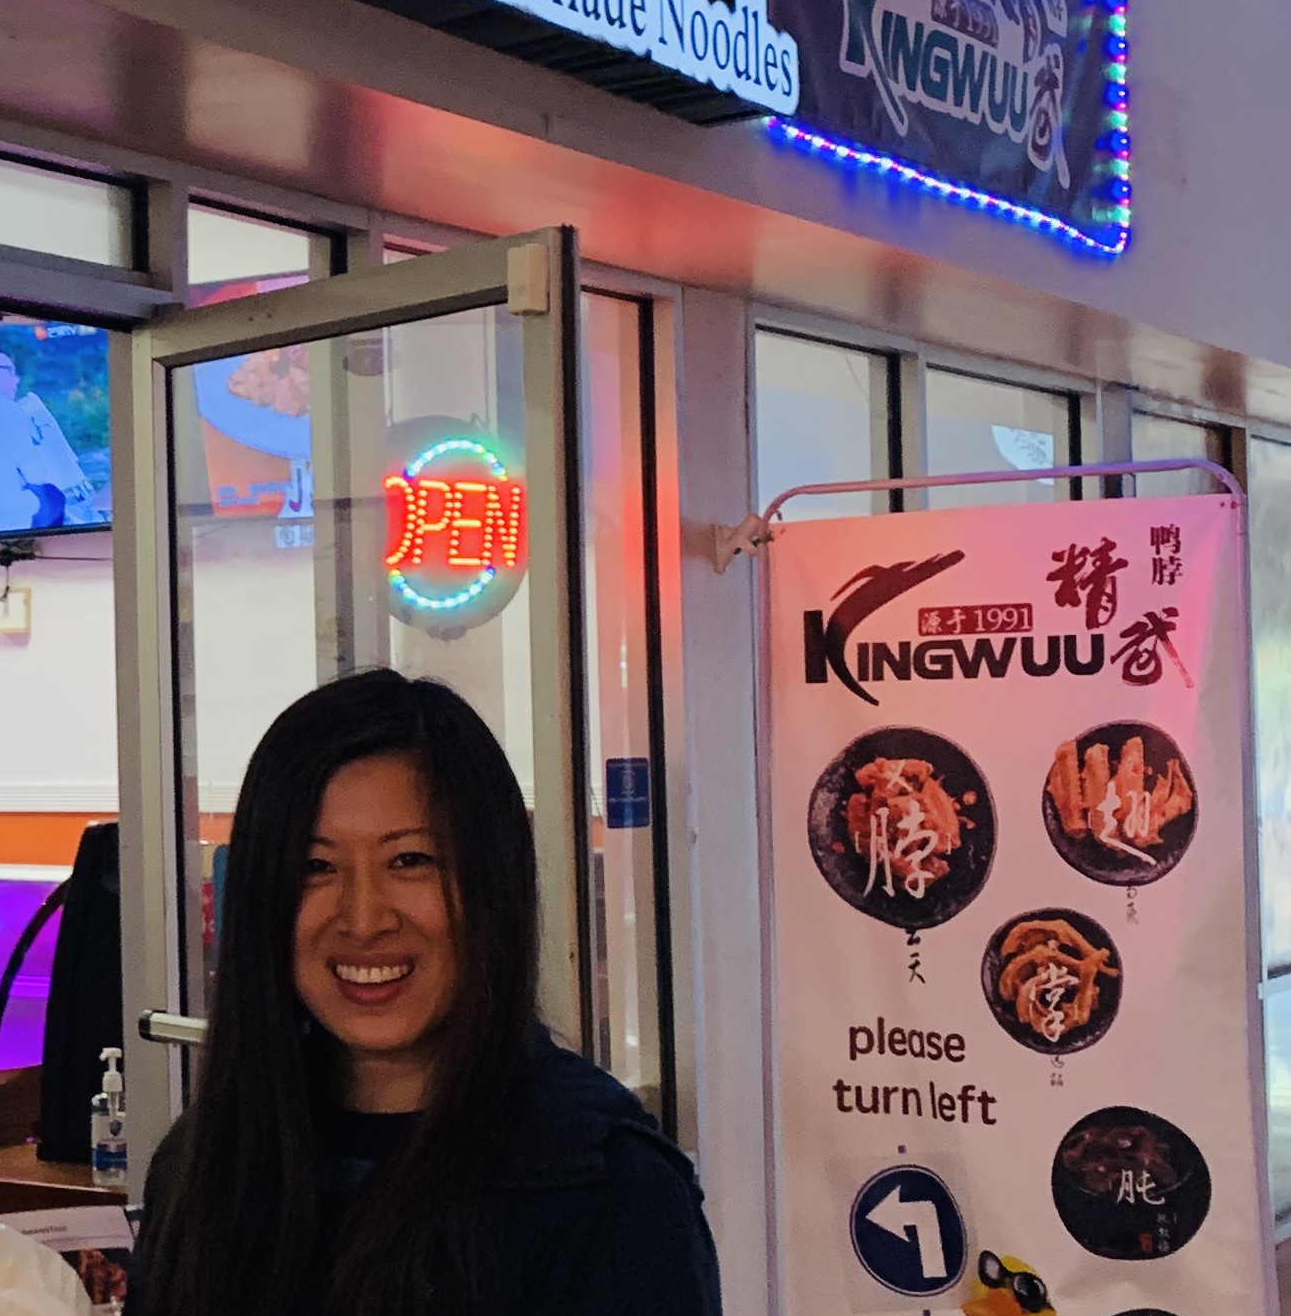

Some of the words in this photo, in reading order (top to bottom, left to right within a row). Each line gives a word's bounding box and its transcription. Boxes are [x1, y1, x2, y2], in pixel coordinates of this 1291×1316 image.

[1150, 524, 1183, 585] 鸭脖
[804, 549, 1105, 706] KINGWUU
[849, 1016, 966, 1062] please
[832, 1079, 922, 1117] turn
[929, 1080, 997, 1125] left
